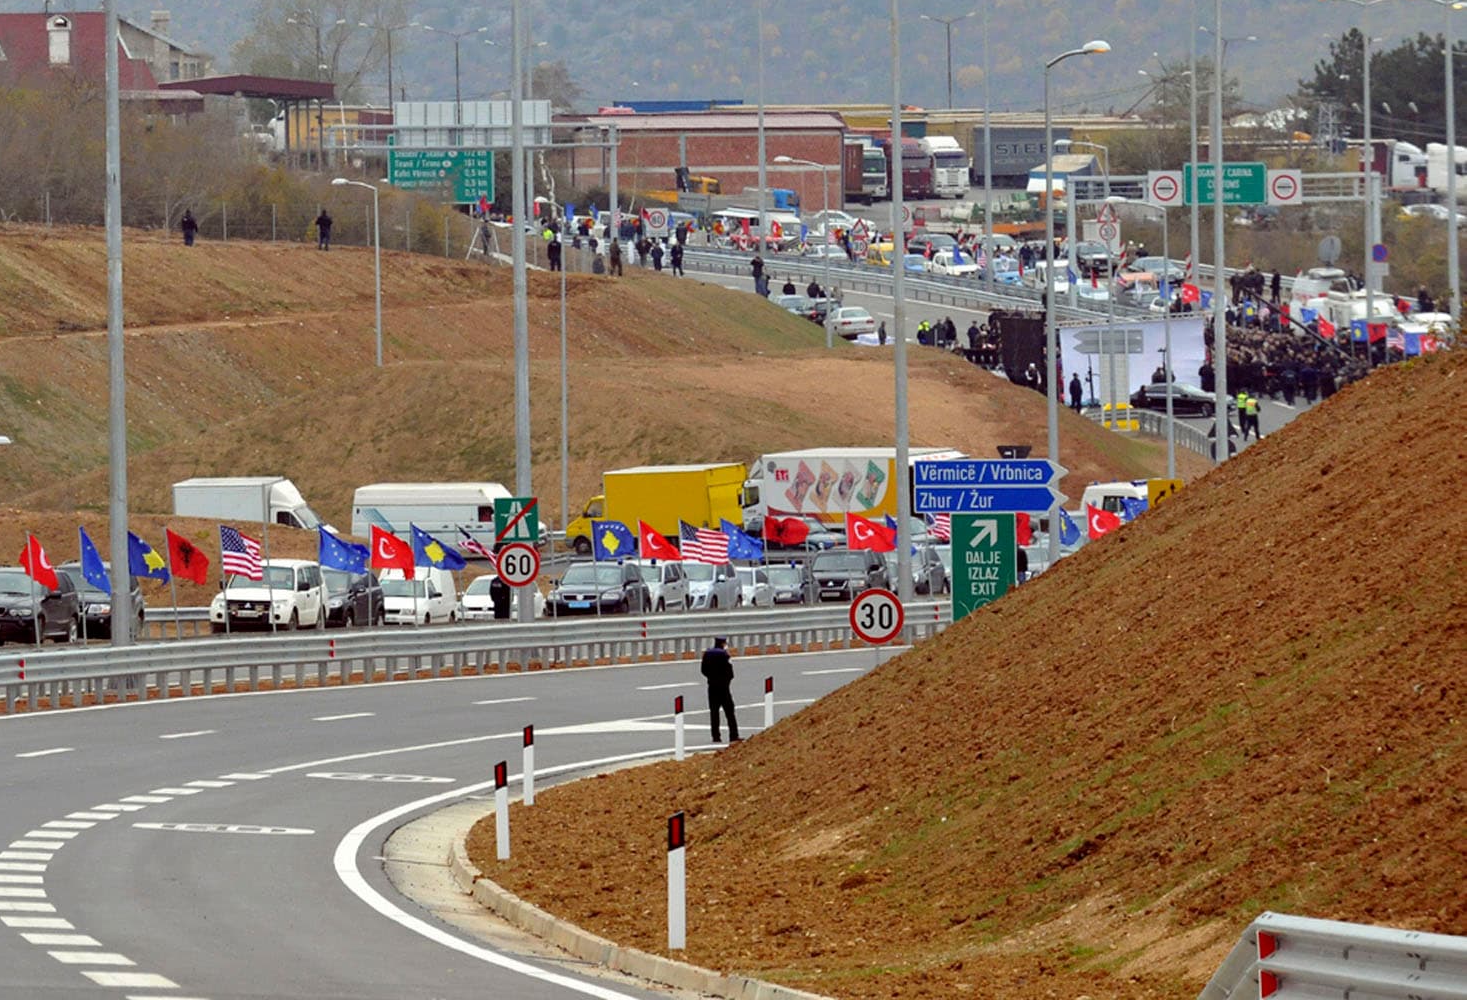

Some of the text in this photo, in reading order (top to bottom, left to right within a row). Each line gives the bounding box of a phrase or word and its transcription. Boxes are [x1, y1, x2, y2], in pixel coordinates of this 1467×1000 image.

[919, 463, 1043, 482] Vërmicë / Vrbnica
[919, 489, 994, 511] Zhur / Žur
[505, 554, 531, 576] 60
[965, 551, 1001, 565] DALJE
[968, 566, 999, 580] IZLAZ
[971, 581, 997, 595] EXIT
[860, 602, 893, 630] 30
